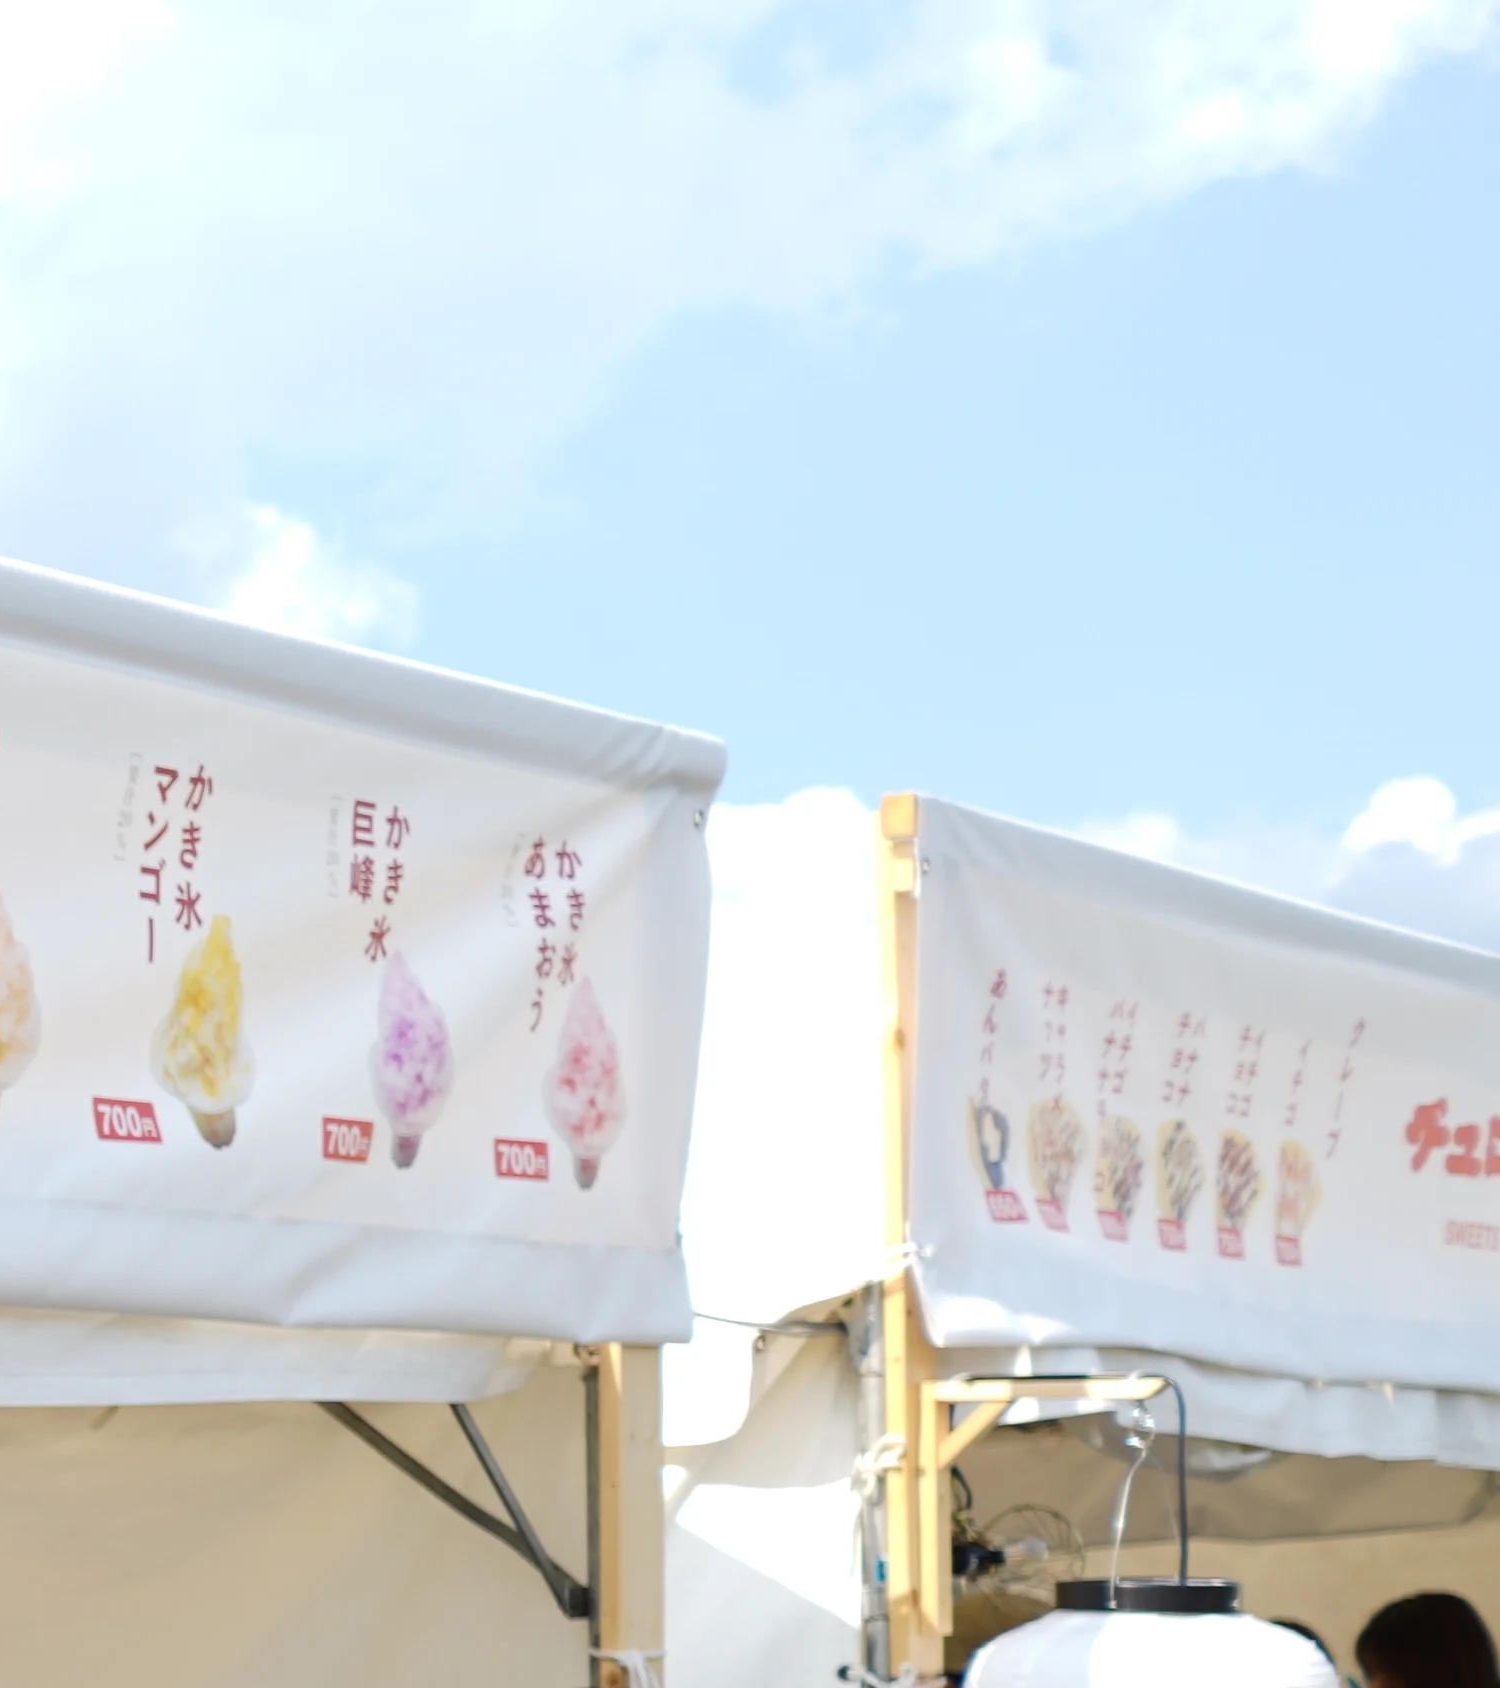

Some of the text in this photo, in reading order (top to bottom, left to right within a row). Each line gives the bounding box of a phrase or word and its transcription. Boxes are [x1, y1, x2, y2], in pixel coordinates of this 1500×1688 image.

[139, 766, 178, 963] マンゴー
[175, 764, 213, 931] かき氷
[350, 799, 376, 903] 巨峰
[364, 806, 409, 962] かき氷
[556, 841, 585, 987] かき氷
[524, 836, 555, 1032] あまおう
[98, 1106, 158, 1138] 700円
